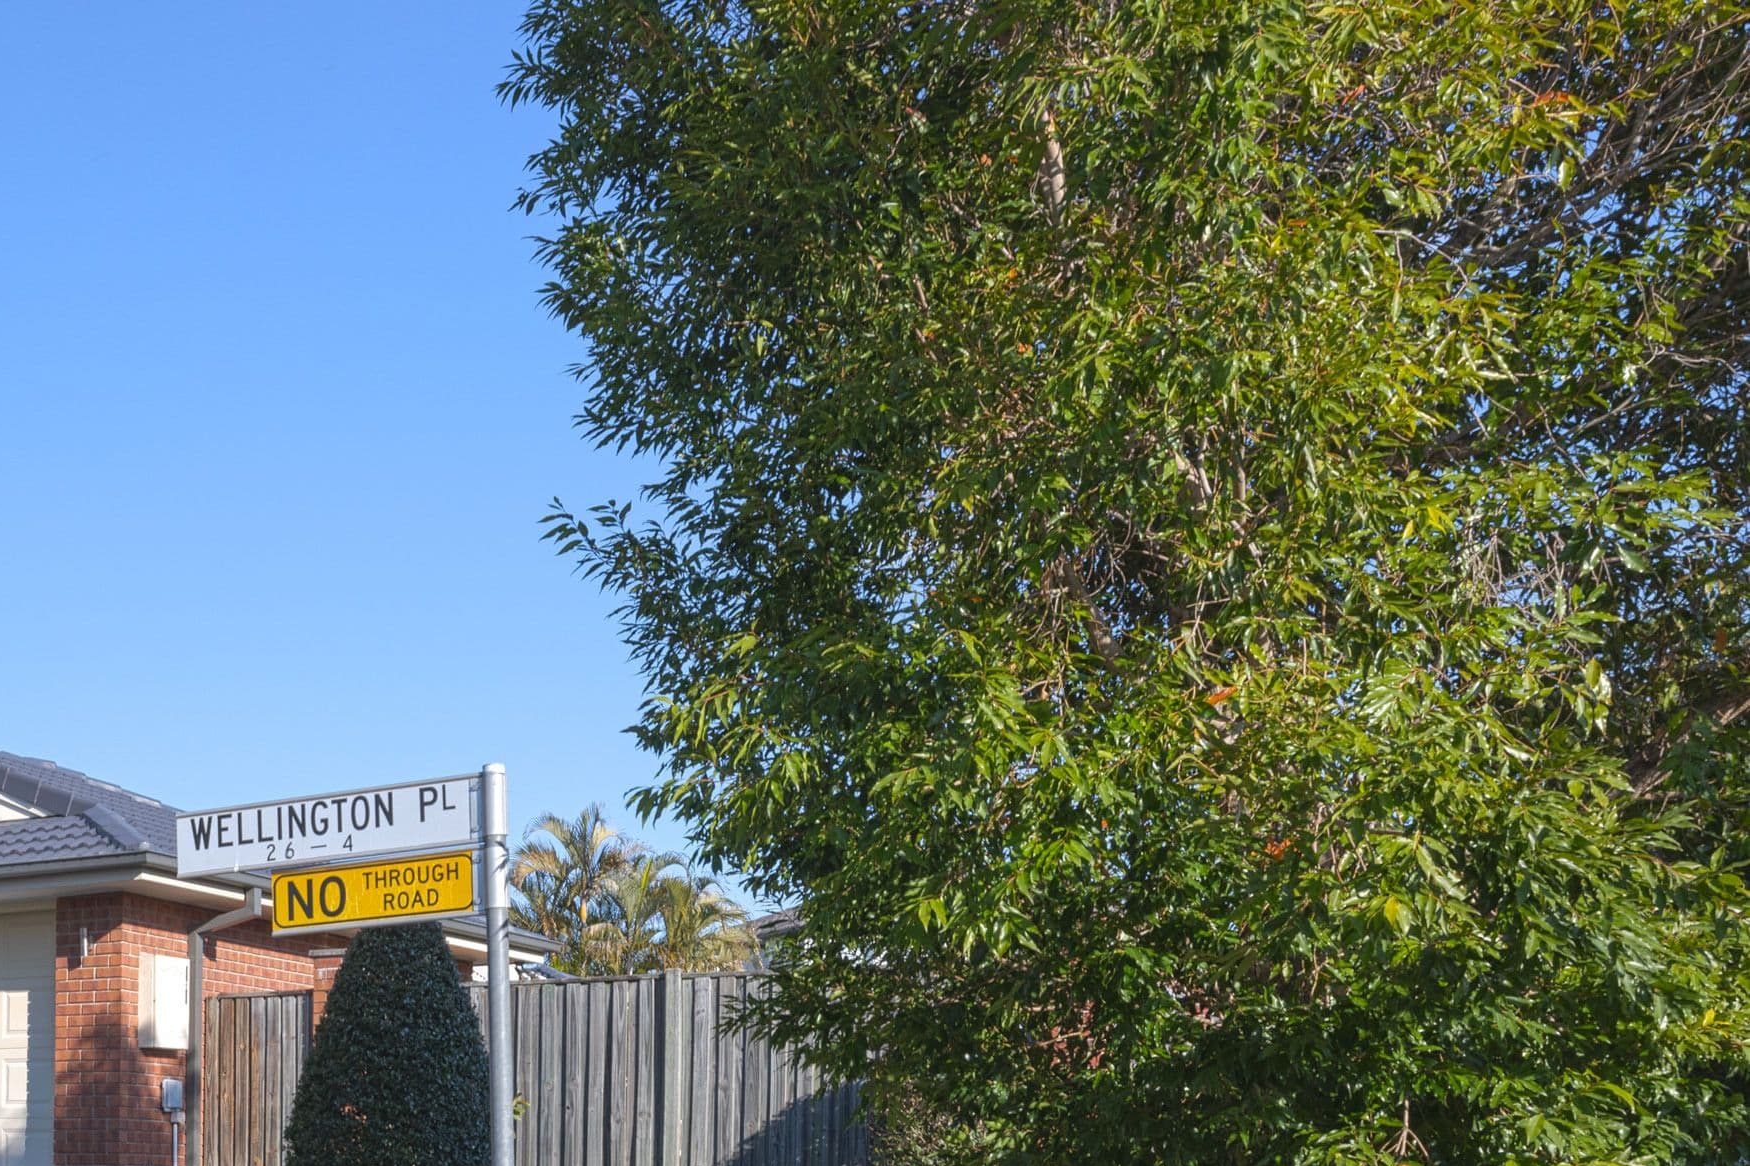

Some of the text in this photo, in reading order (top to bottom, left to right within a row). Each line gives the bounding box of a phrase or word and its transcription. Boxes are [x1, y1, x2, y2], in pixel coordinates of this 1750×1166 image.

[191, 784, 456, 851] WELLINGTON PL
[266, 842, 295, 861] 26
[343, 834, 354, 851] 4
[362, 862, 459, 889] THROUGH
[287, 876, 347, 921] NO
[383, 889, 439, 911] ROAD
